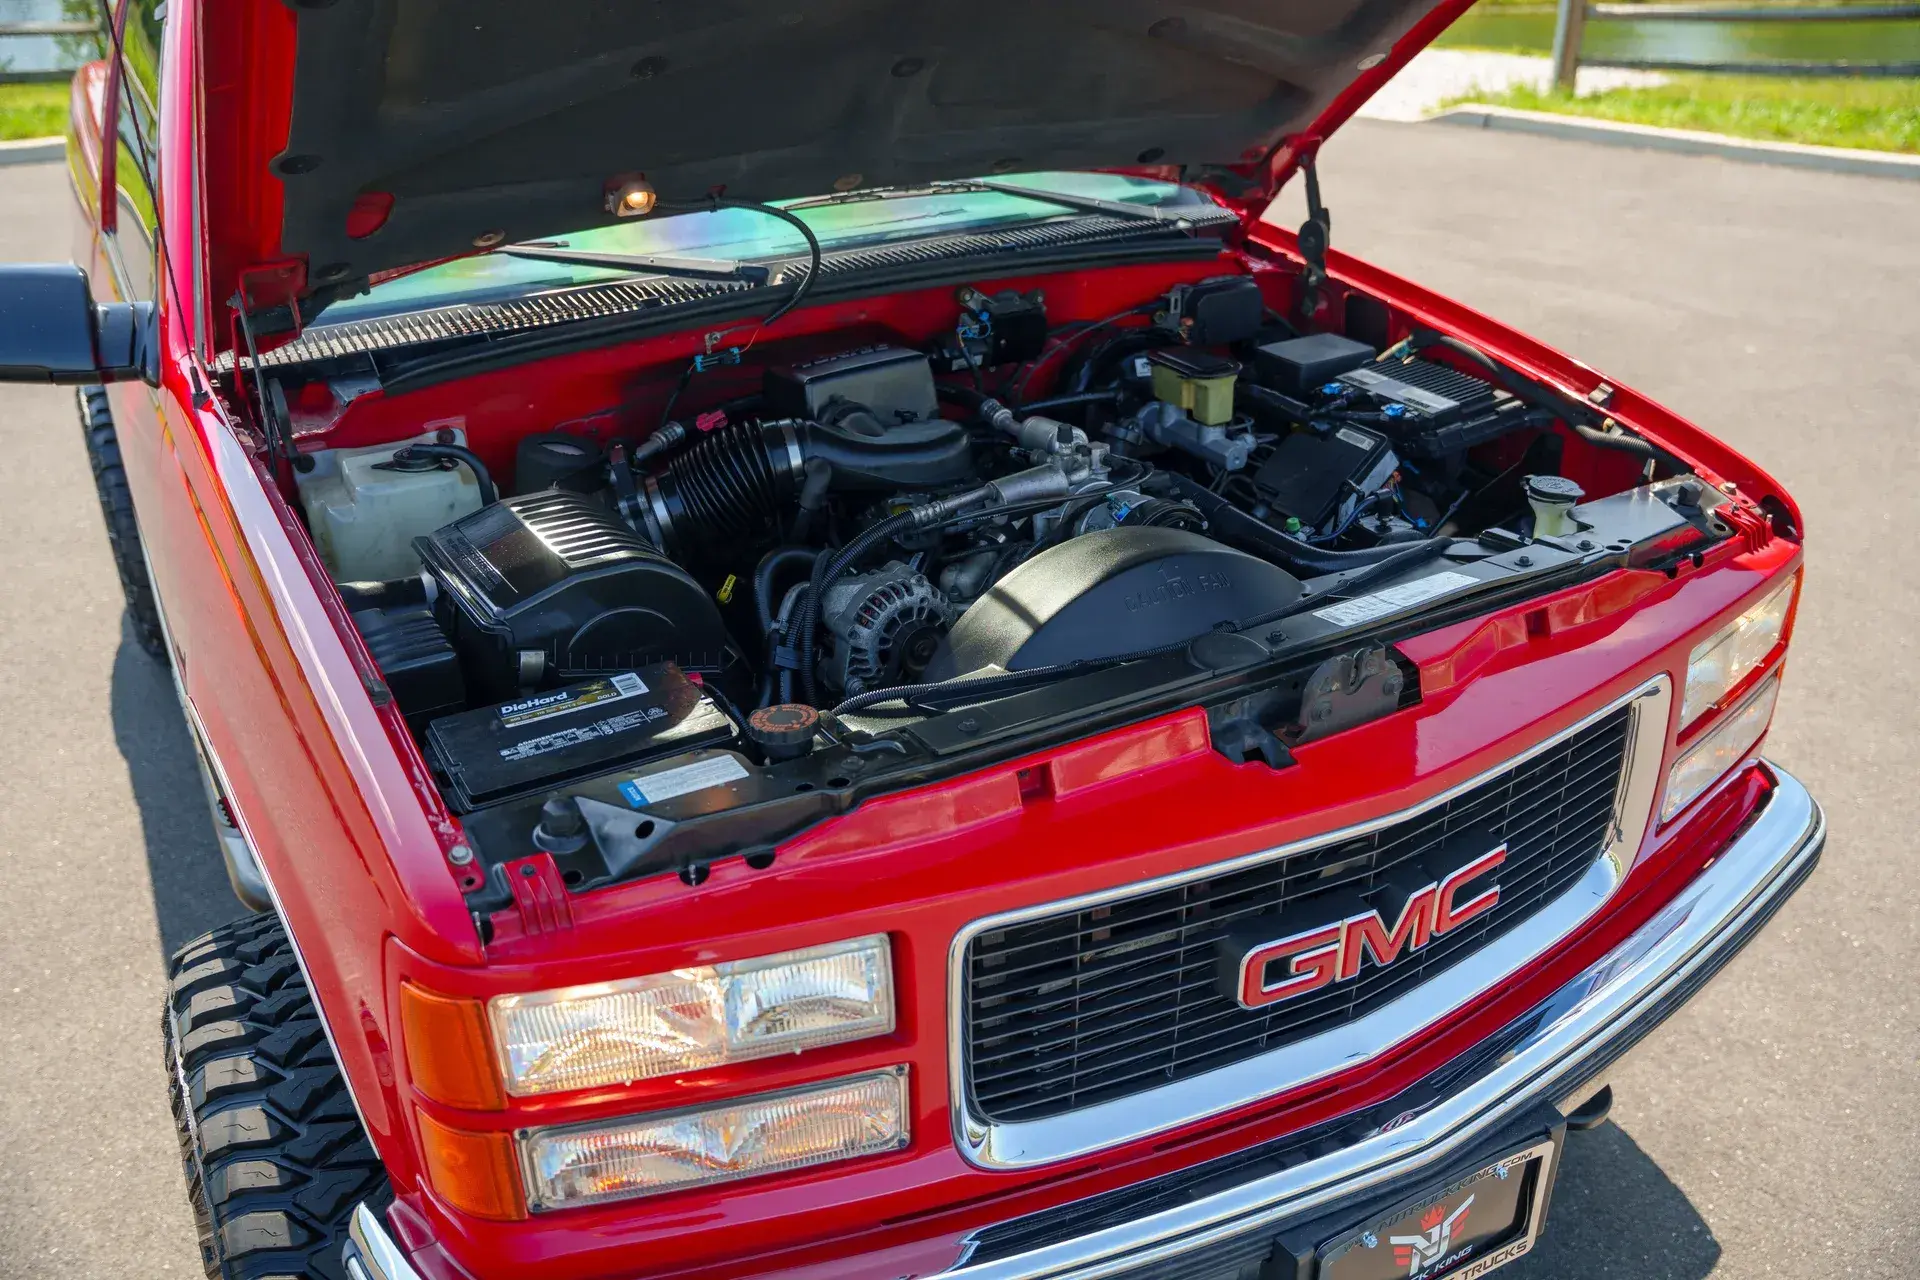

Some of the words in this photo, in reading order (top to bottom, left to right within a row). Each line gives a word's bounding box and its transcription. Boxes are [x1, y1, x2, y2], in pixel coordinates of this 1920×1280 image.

[1124, 578, 1196, 612] CAUTION
[1198, 571, 1231, 592] FAN
[501, 692, 567, 714] DieHard
[1237, 843, 1507, 1010] GMC
[1434, 1244, 1473, 1272] KING
[1461, 1240, 1528, 1280] TRUCKS
